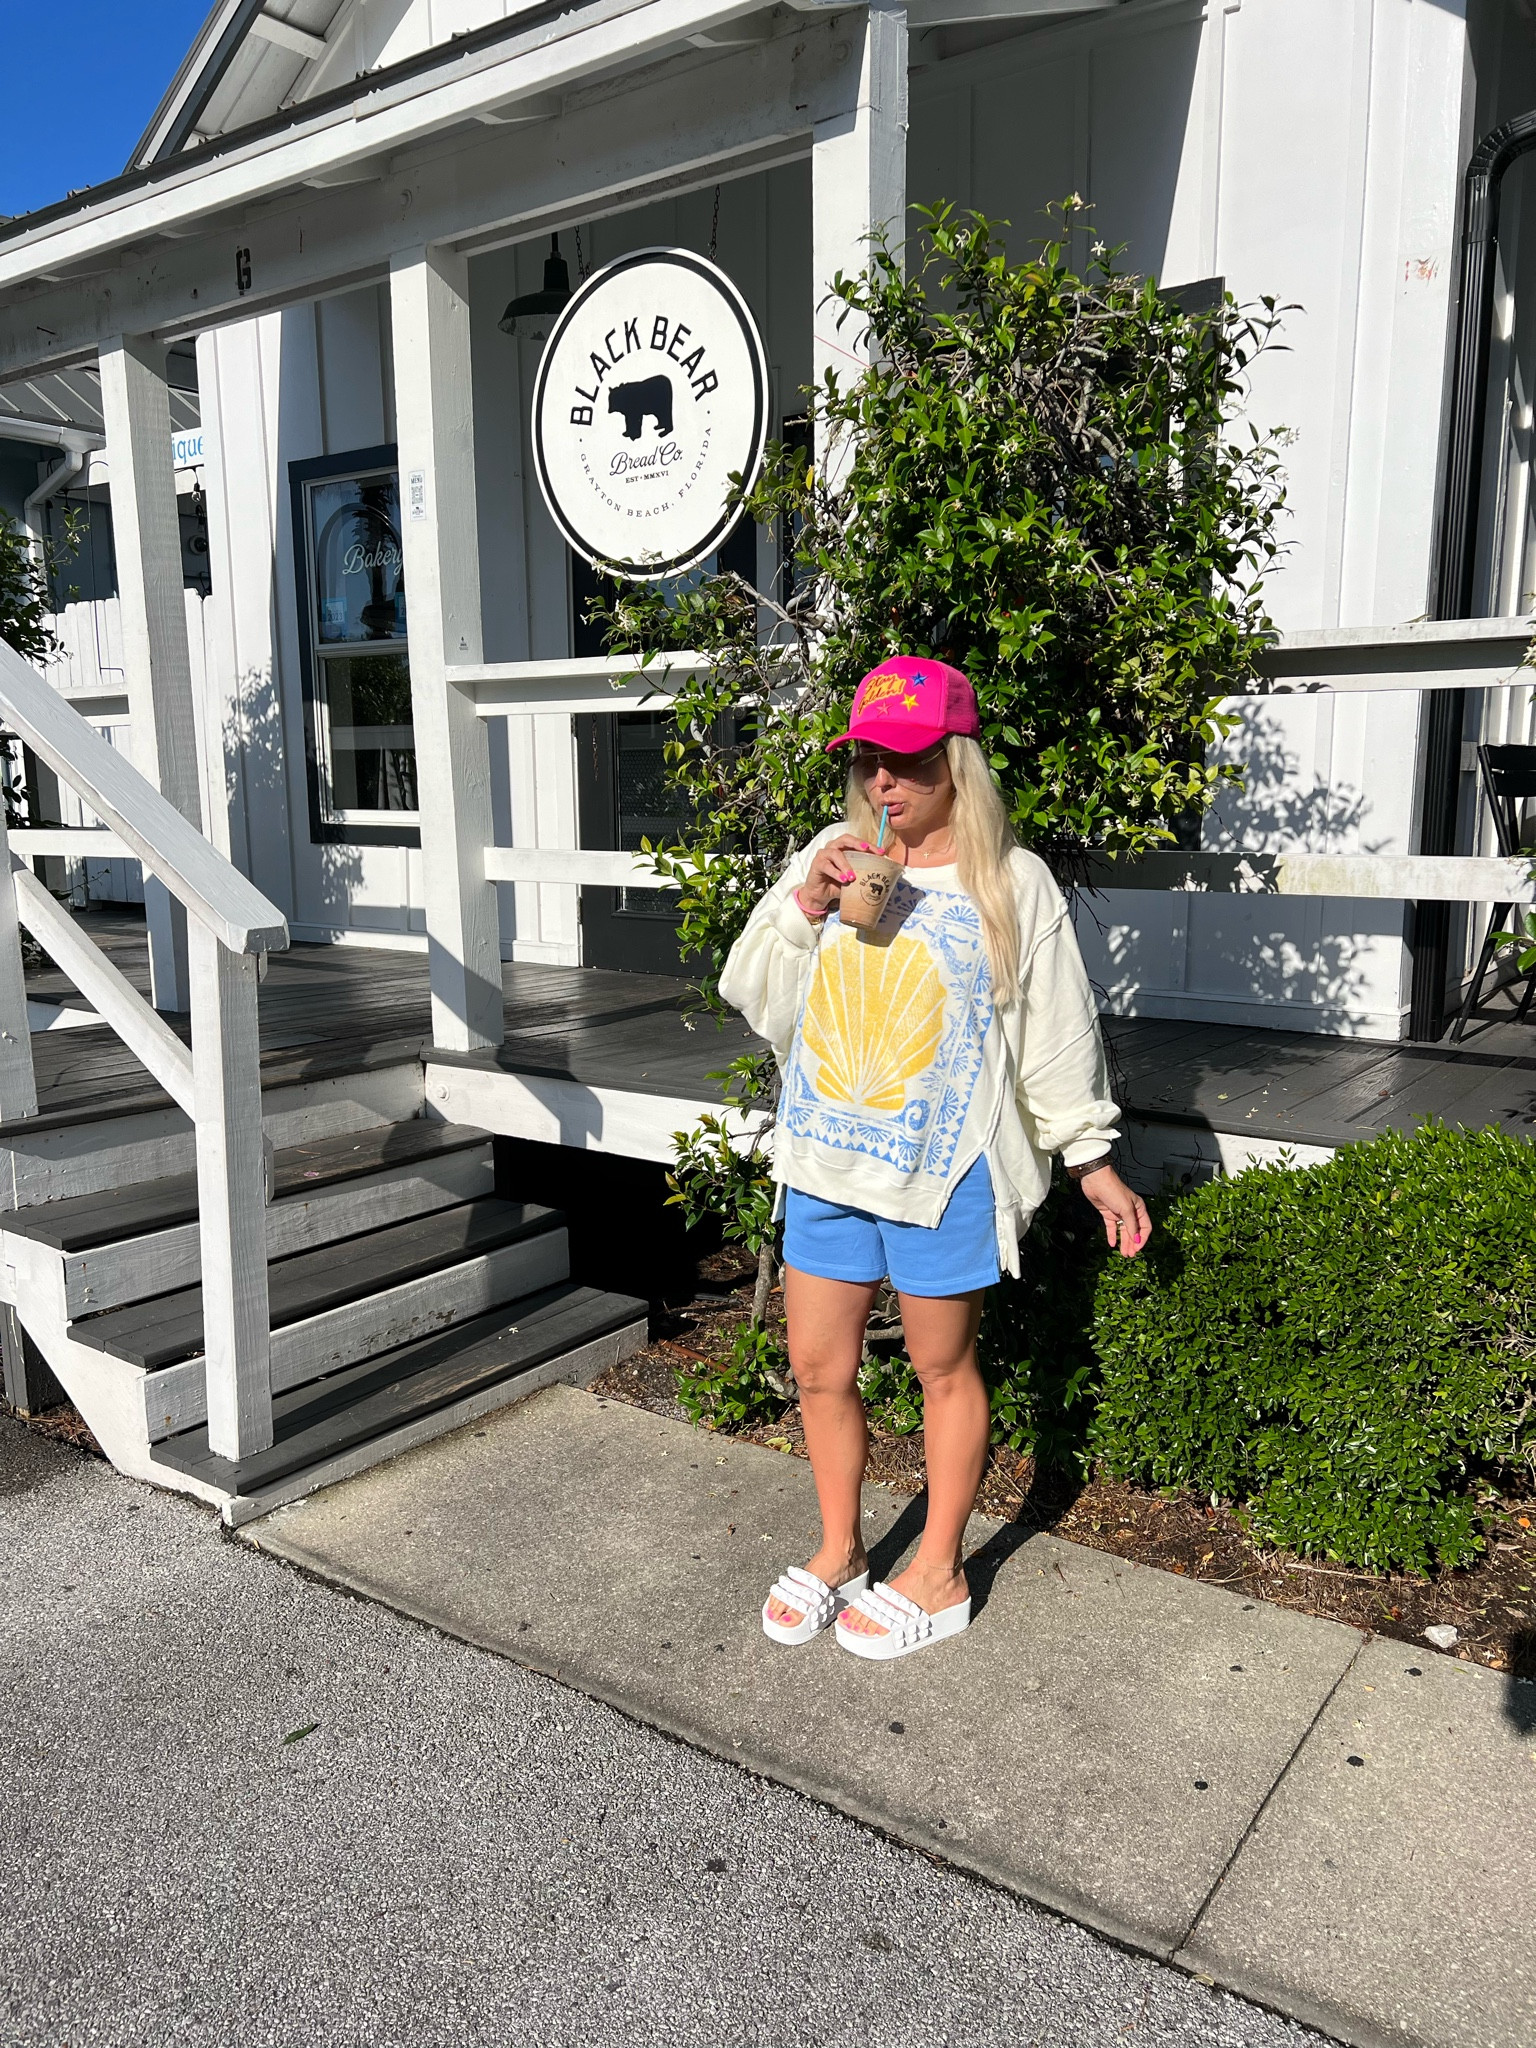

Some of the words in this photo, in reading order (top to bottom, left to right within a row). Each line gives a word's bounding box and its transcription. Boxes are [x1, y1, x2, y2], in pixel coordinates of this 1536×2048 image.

[570, 317, 641, 426] BLACK
[649, 315, 719, 402] BEAR
[580, 453, 621, 512] GRAYTON
[678, 427, 712, 498] FLORIDA
[609, 445, 658, 475] Bread
[659, 441, 683, 466] Co.
[643, 470, 669, 480] MMXVI
[859, 873, 880, 886] BLACK
